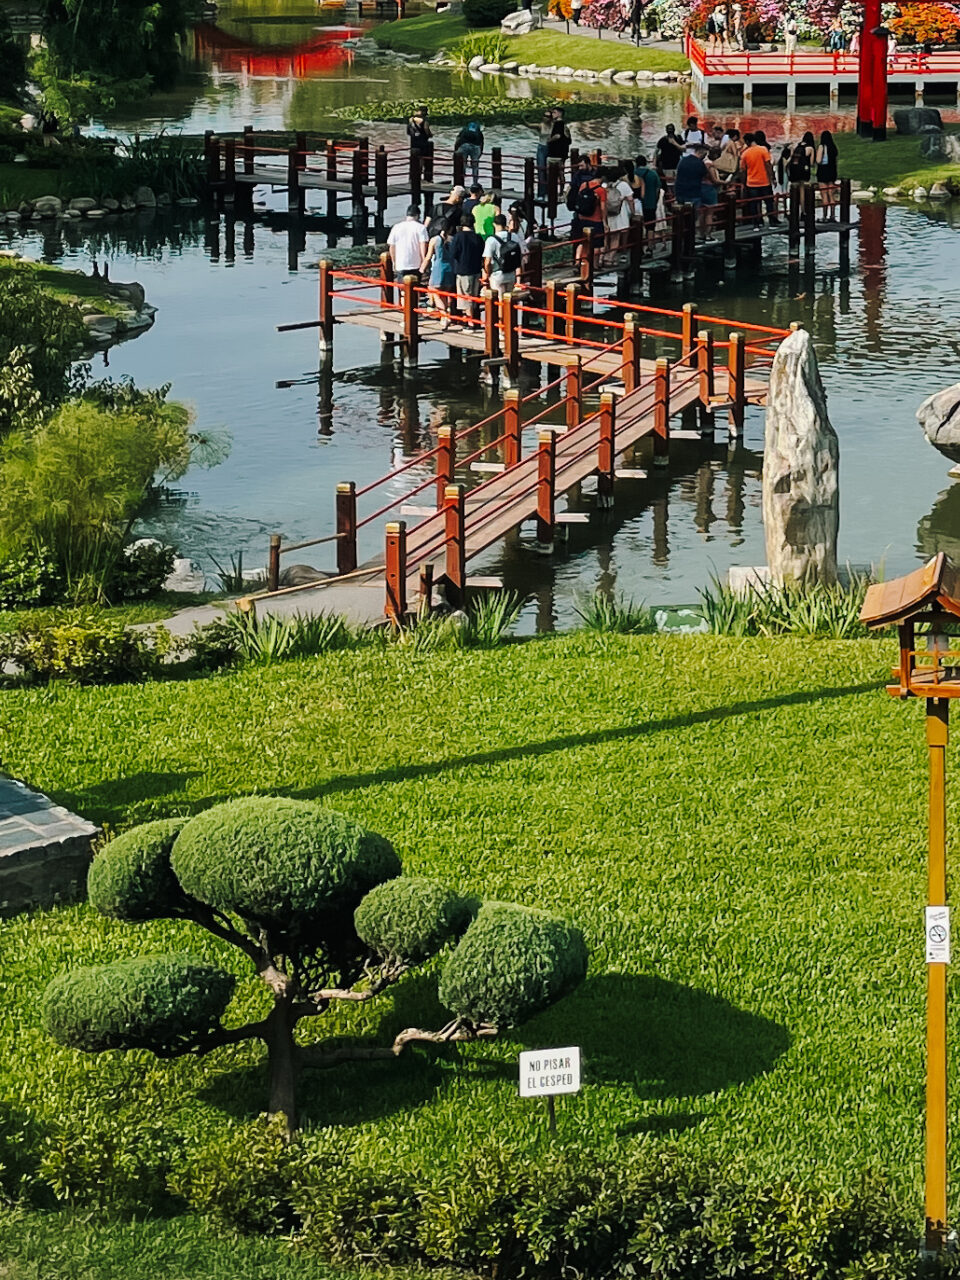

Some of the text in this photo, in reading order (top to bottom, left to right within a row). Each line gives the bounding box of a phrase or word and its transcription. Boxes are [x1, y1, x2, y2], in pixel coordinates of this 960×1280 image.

[529, 1057, 571, 1072] NO PISAR
[527, 1073, 573, 1089] EL CESPED
